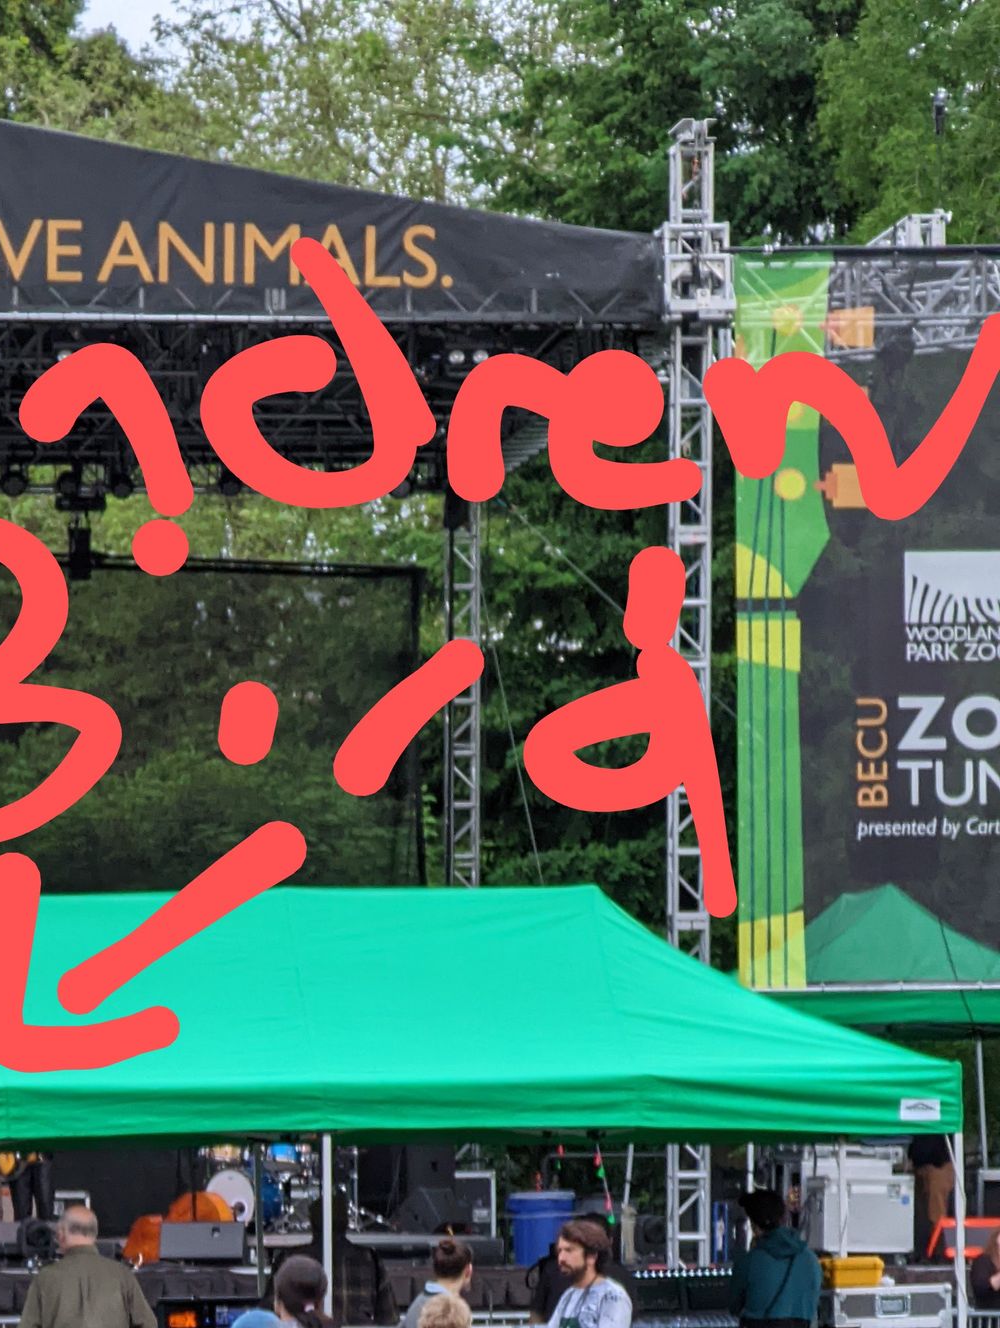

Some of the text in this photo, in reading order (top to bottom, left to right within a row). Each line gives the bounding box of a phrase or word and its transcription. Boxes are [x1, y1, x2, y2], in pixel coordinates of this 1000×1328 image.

[97, 220, 455, 290] ANIMALS.
[906, 643, 1000, 661] PARK ZO
[856, 697, 889, 808] BECU
[857, 819, 937, 841] presented
[942, 817, 961, 840] by
